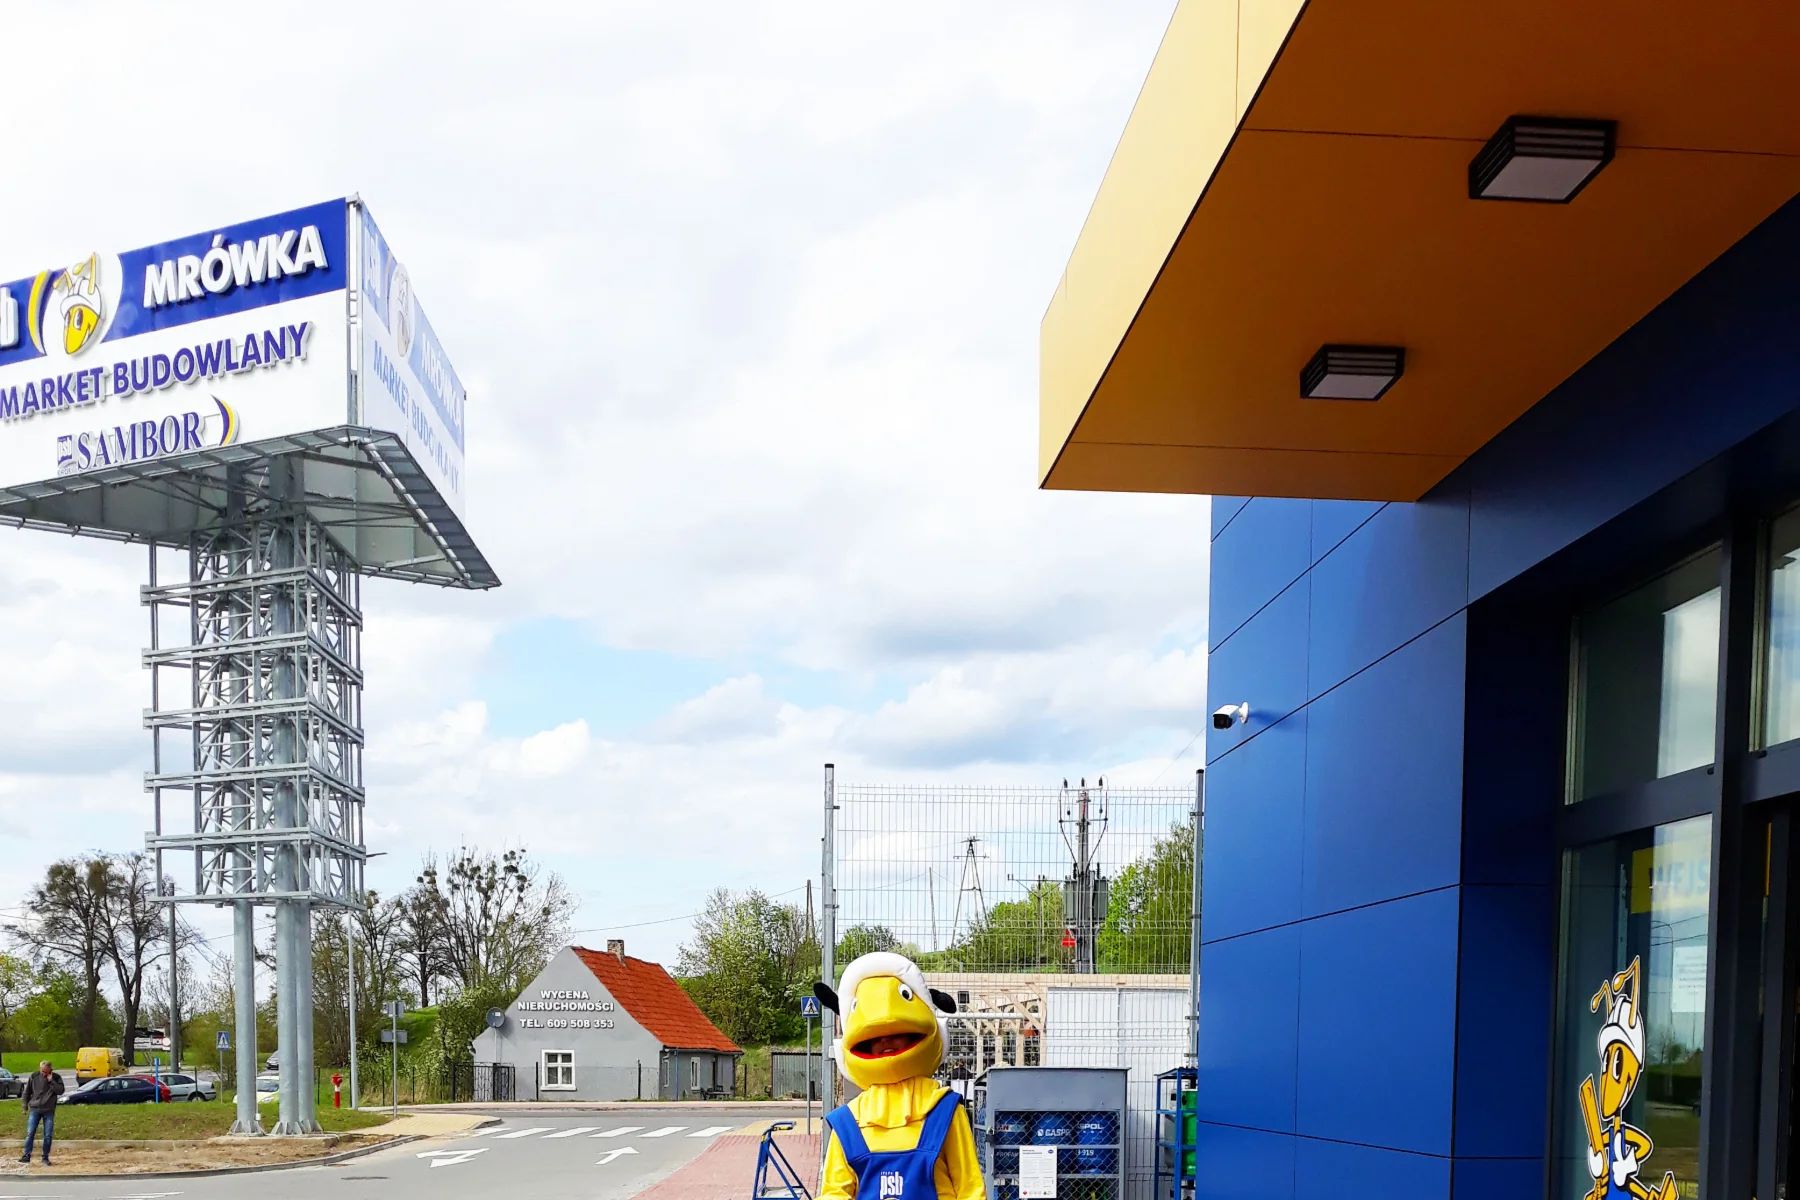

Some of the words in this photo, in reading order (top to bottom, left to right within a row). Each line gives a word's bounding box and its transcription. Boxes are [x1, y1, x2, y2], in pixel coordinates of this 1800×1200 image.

[143, 225, 328, 308] MRÓWKA
[0, 366, 104, 419] MARKET
[113, 321, 309, 396] BUDOWLANY
[374, 340, 410, 419] MARKET
[77, 410, 203, 470] SAMBOR
[517, 1000, 615, 1012] NIERUCHOMOŚCI
[540, 990, 590, 1000] WYCENA
[520, 1019, 544, 1028] TEL.
[547, 1019, 568, 1028] 609
[570, 1019, 591, 1028] 508
[593, 1019, 614, 1028] 353
[880, 1171, 903, 1200] psb
